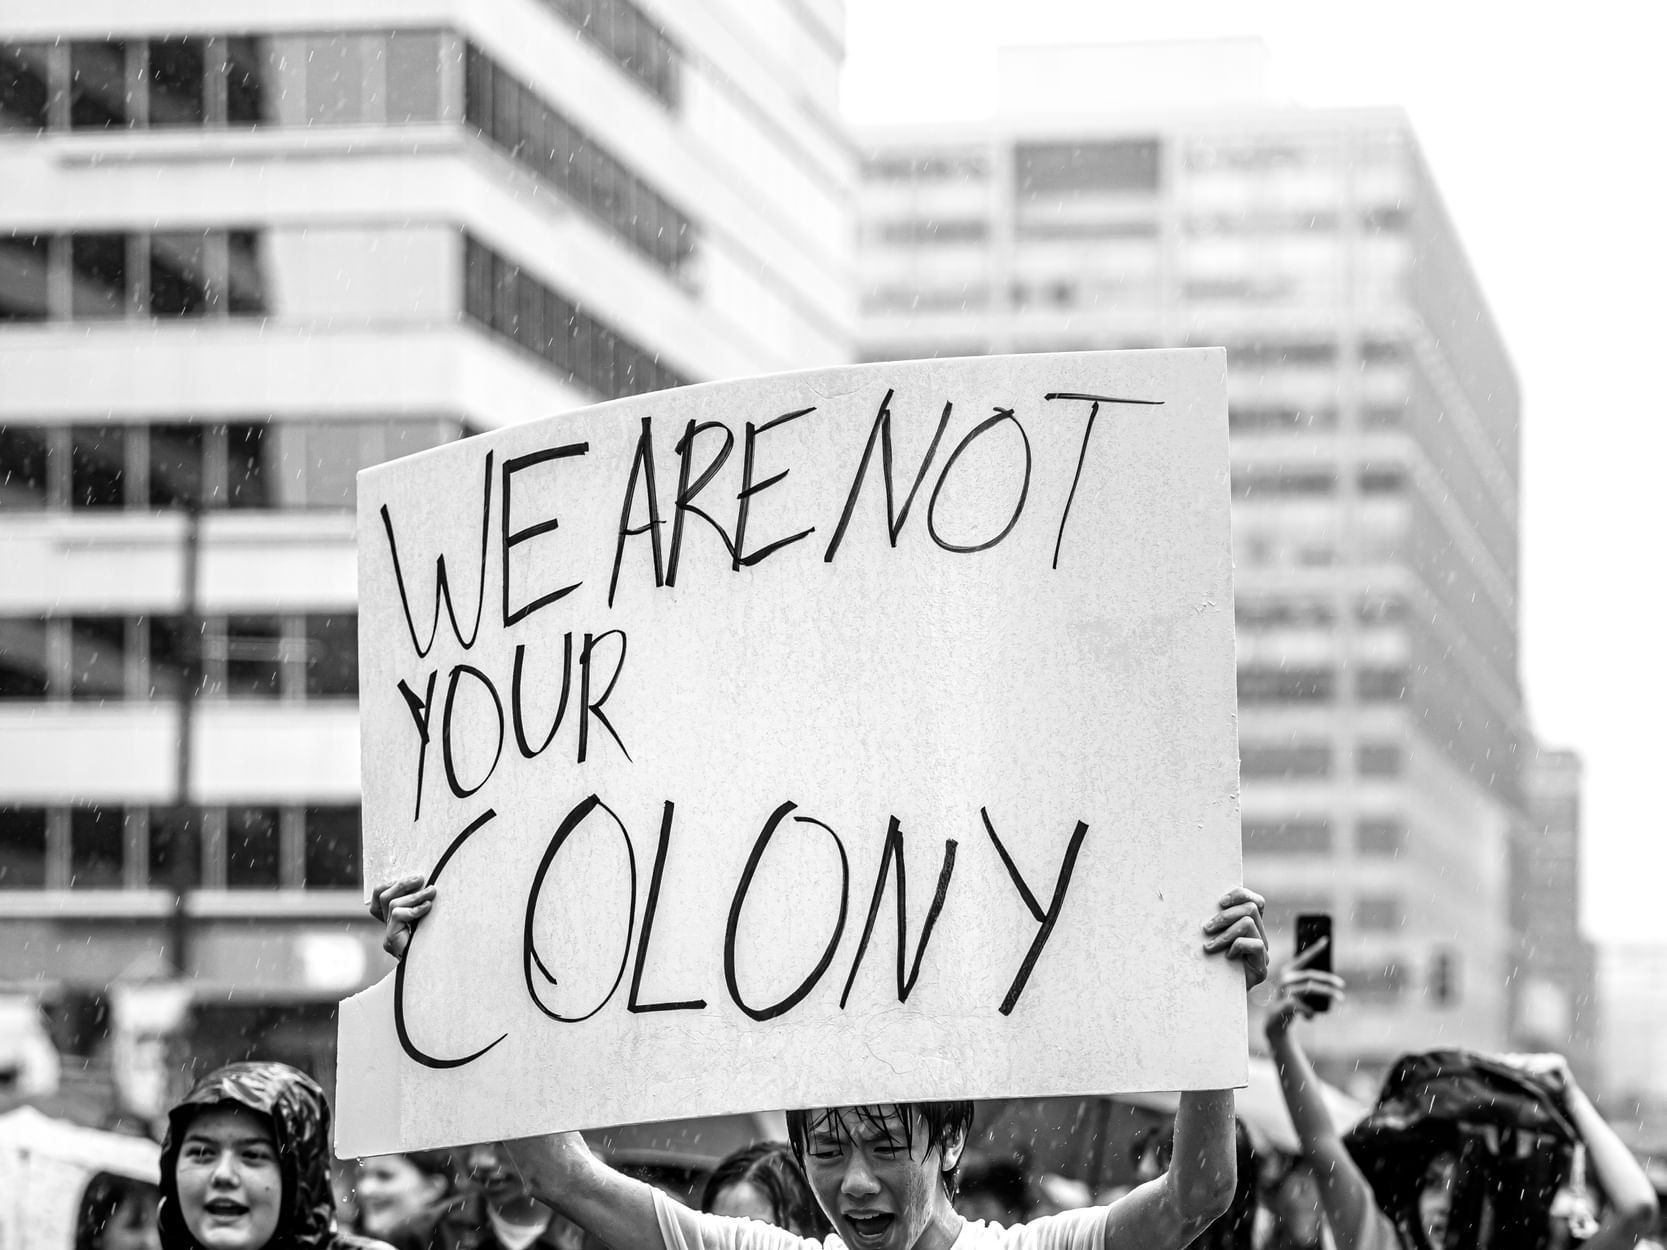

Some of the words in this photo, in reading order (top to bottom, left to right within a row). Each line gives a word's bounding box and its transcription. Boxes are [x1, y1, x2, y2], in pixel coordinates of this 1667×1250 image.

[381, 442, 589, 659] WE
[608, 406, 818, 609] ARE
[824, 388, 1166, 570] NOT
[397, 629, 632, 822] YOUR
[394, 793, 1089, 1069] COLONY
